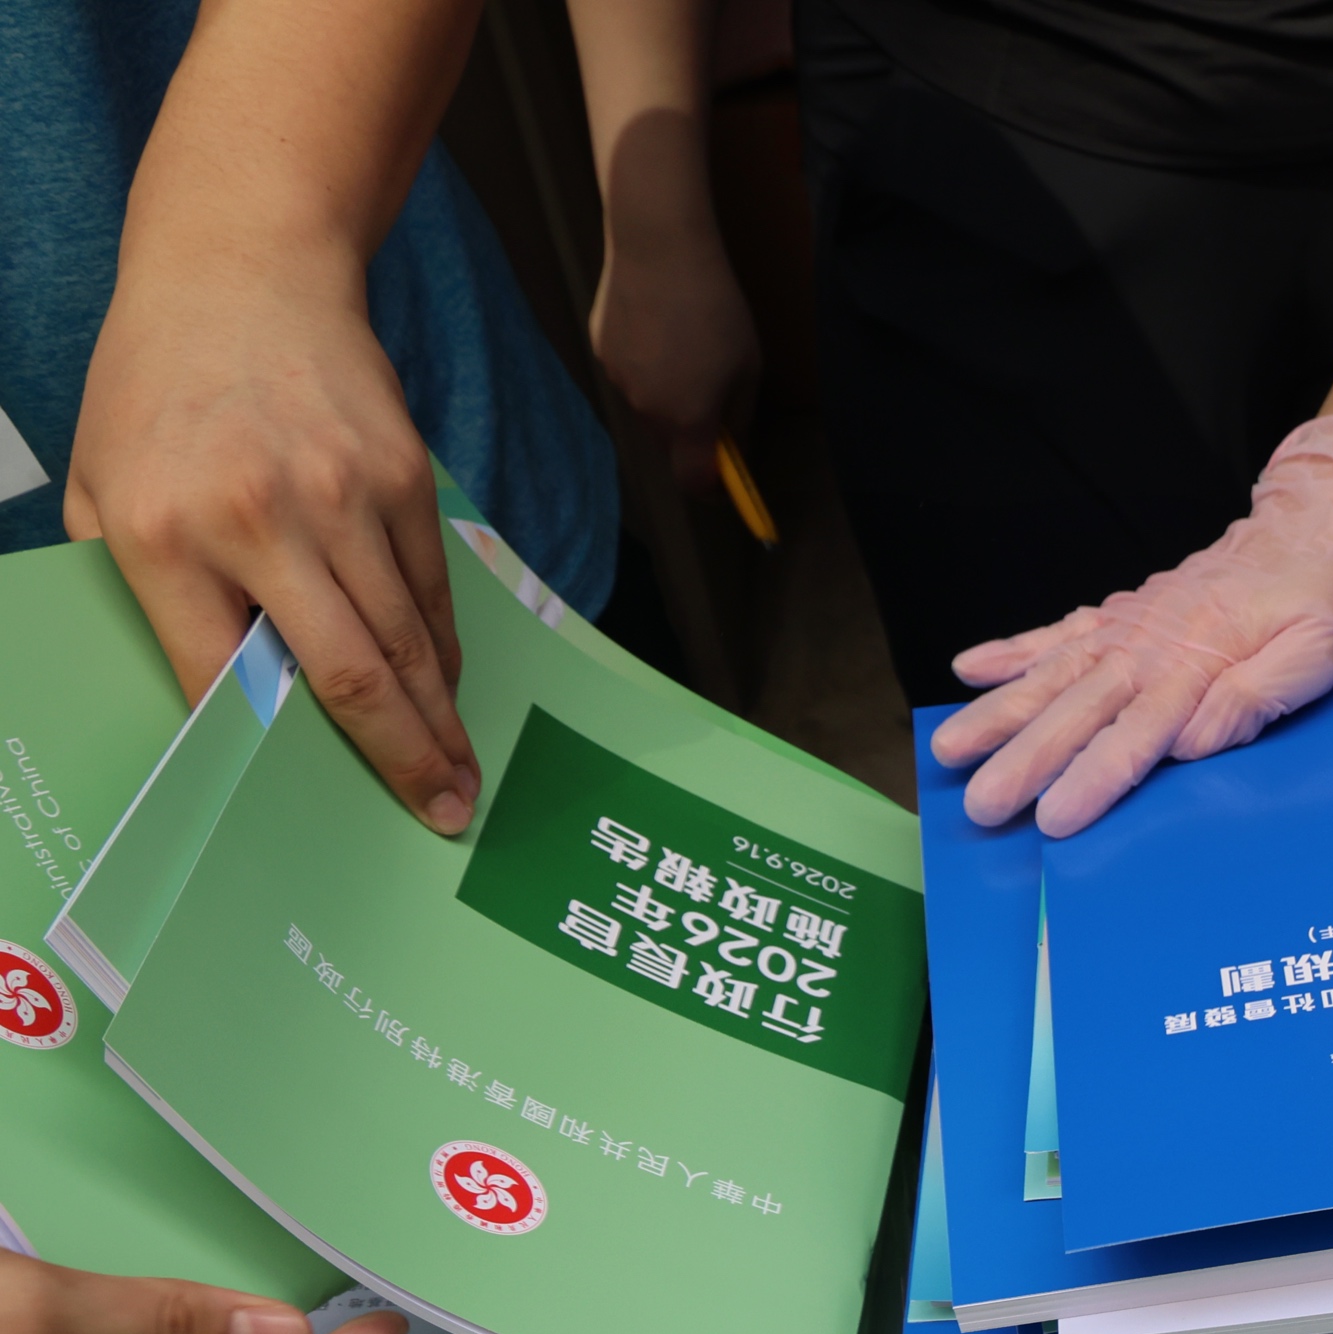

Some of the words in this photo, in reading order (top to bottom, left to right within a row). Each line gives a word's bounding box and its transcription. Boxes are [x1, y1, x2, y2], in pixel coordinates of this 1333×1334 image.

[6, 737, 61, 818] China
[52, 826, 82, 851] of
[731, 835, 858, 899] 2026.9.16
[590, 815, 849, 959] 施政報告
[23, 952, 53, 981] KONG
[557, 898, 826, 1045] 行政長官
[611, 881, 839, 998] 2026年
[56, 982, 73, 1014] HONG
[283, 922, 783, 1216] 中華人民共和國香港特別行政區
[465, 1143, 499, 1160] KONG
[500, 1155, 530, 1178] HONG
